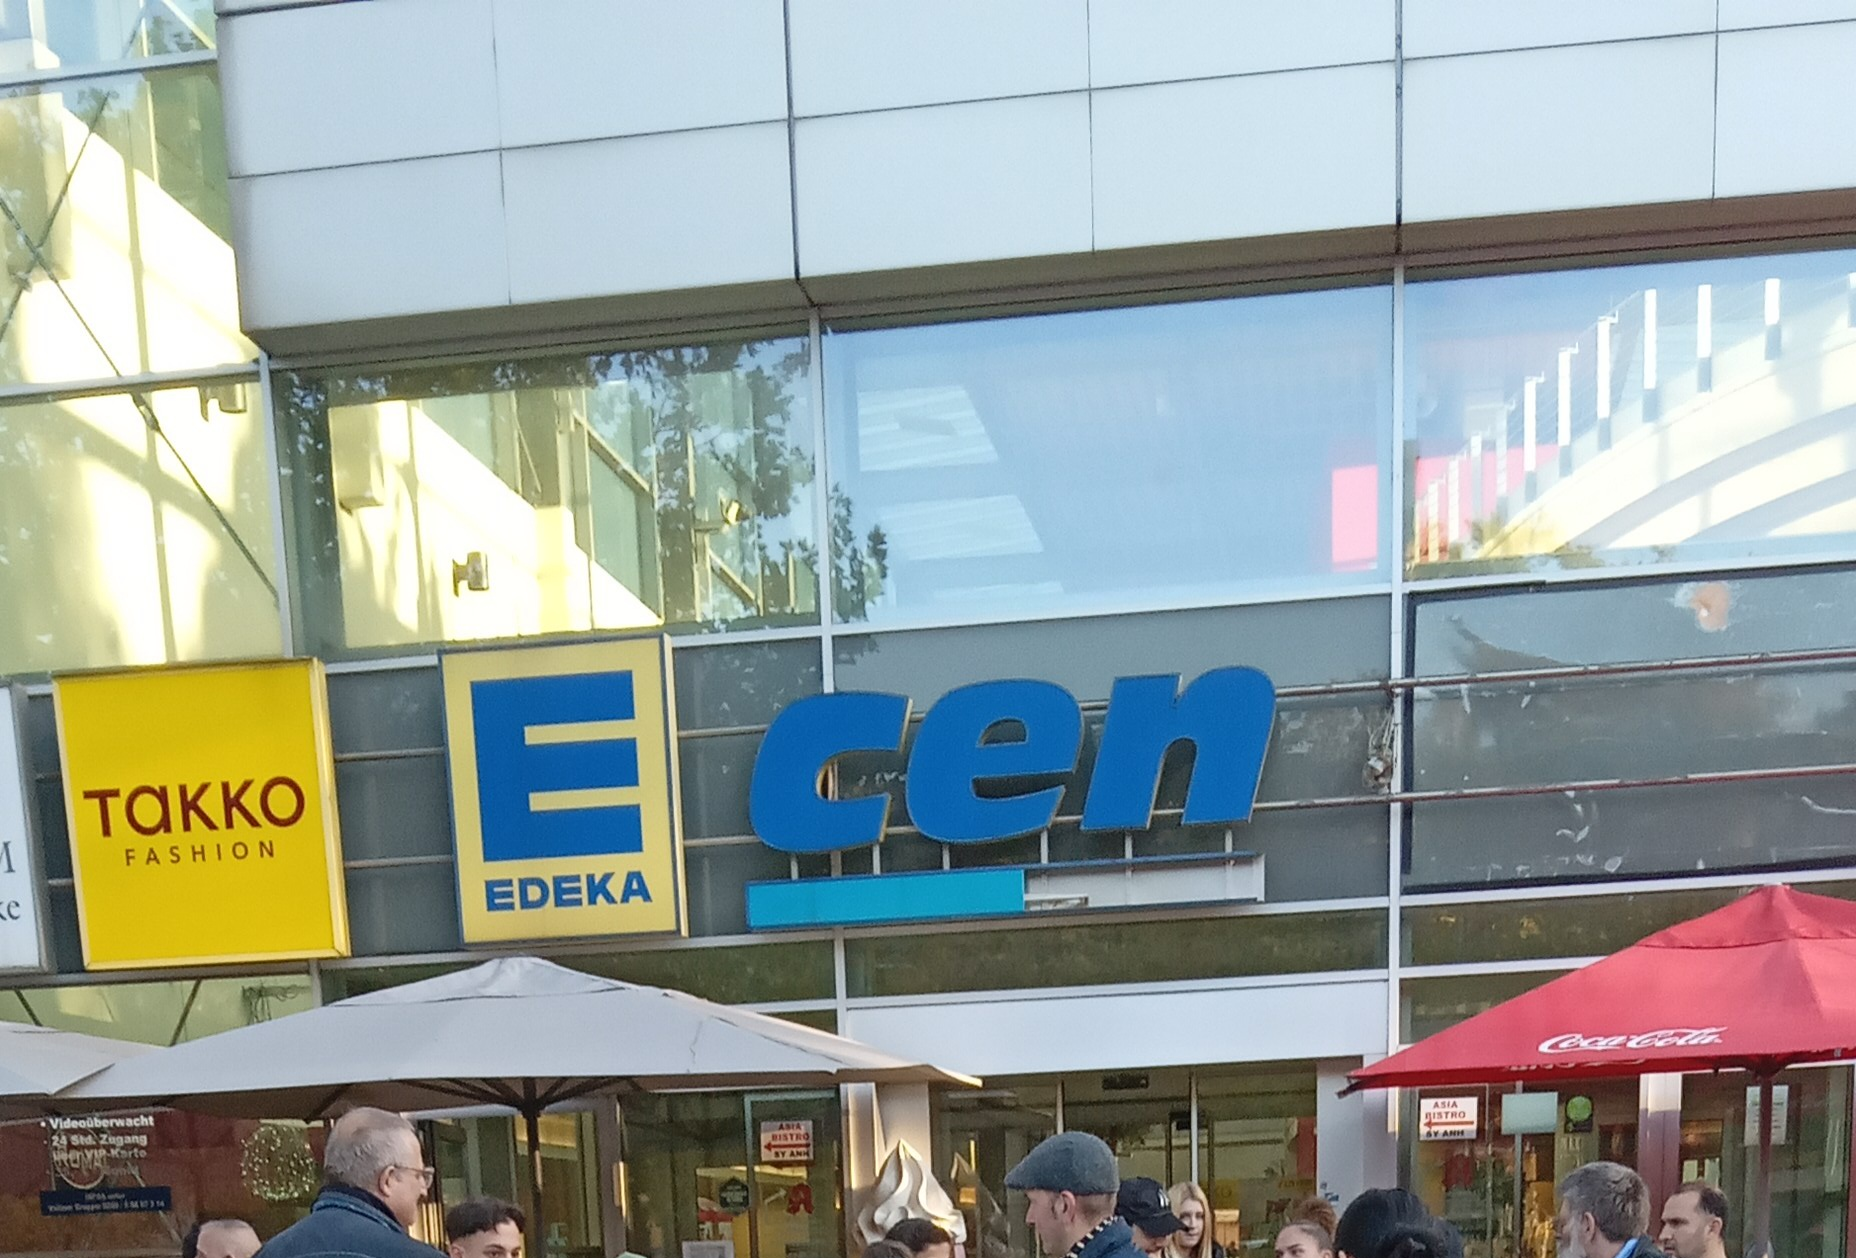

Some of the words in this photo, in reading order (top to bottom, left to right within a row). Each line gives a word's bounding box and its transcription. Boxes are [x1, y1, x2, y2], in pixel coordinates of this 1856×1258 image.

[749, 665, 1277, 853] cen
[125, 840, 275, 867] FASHION
[485, 869, 652, 912] EDEKA
[1538, 1027, 1728, 1053] Coca-Cola
[1433, 1101, 1458, 1109] ASIA
[49, 1115, 154, 1129] Videoüberwacht
[1425, 1111, 1466, 1120] BISTRO
[100, 1133, 148, 1147] Zugang
[772, 1132, 809, 1141] BISTRO
